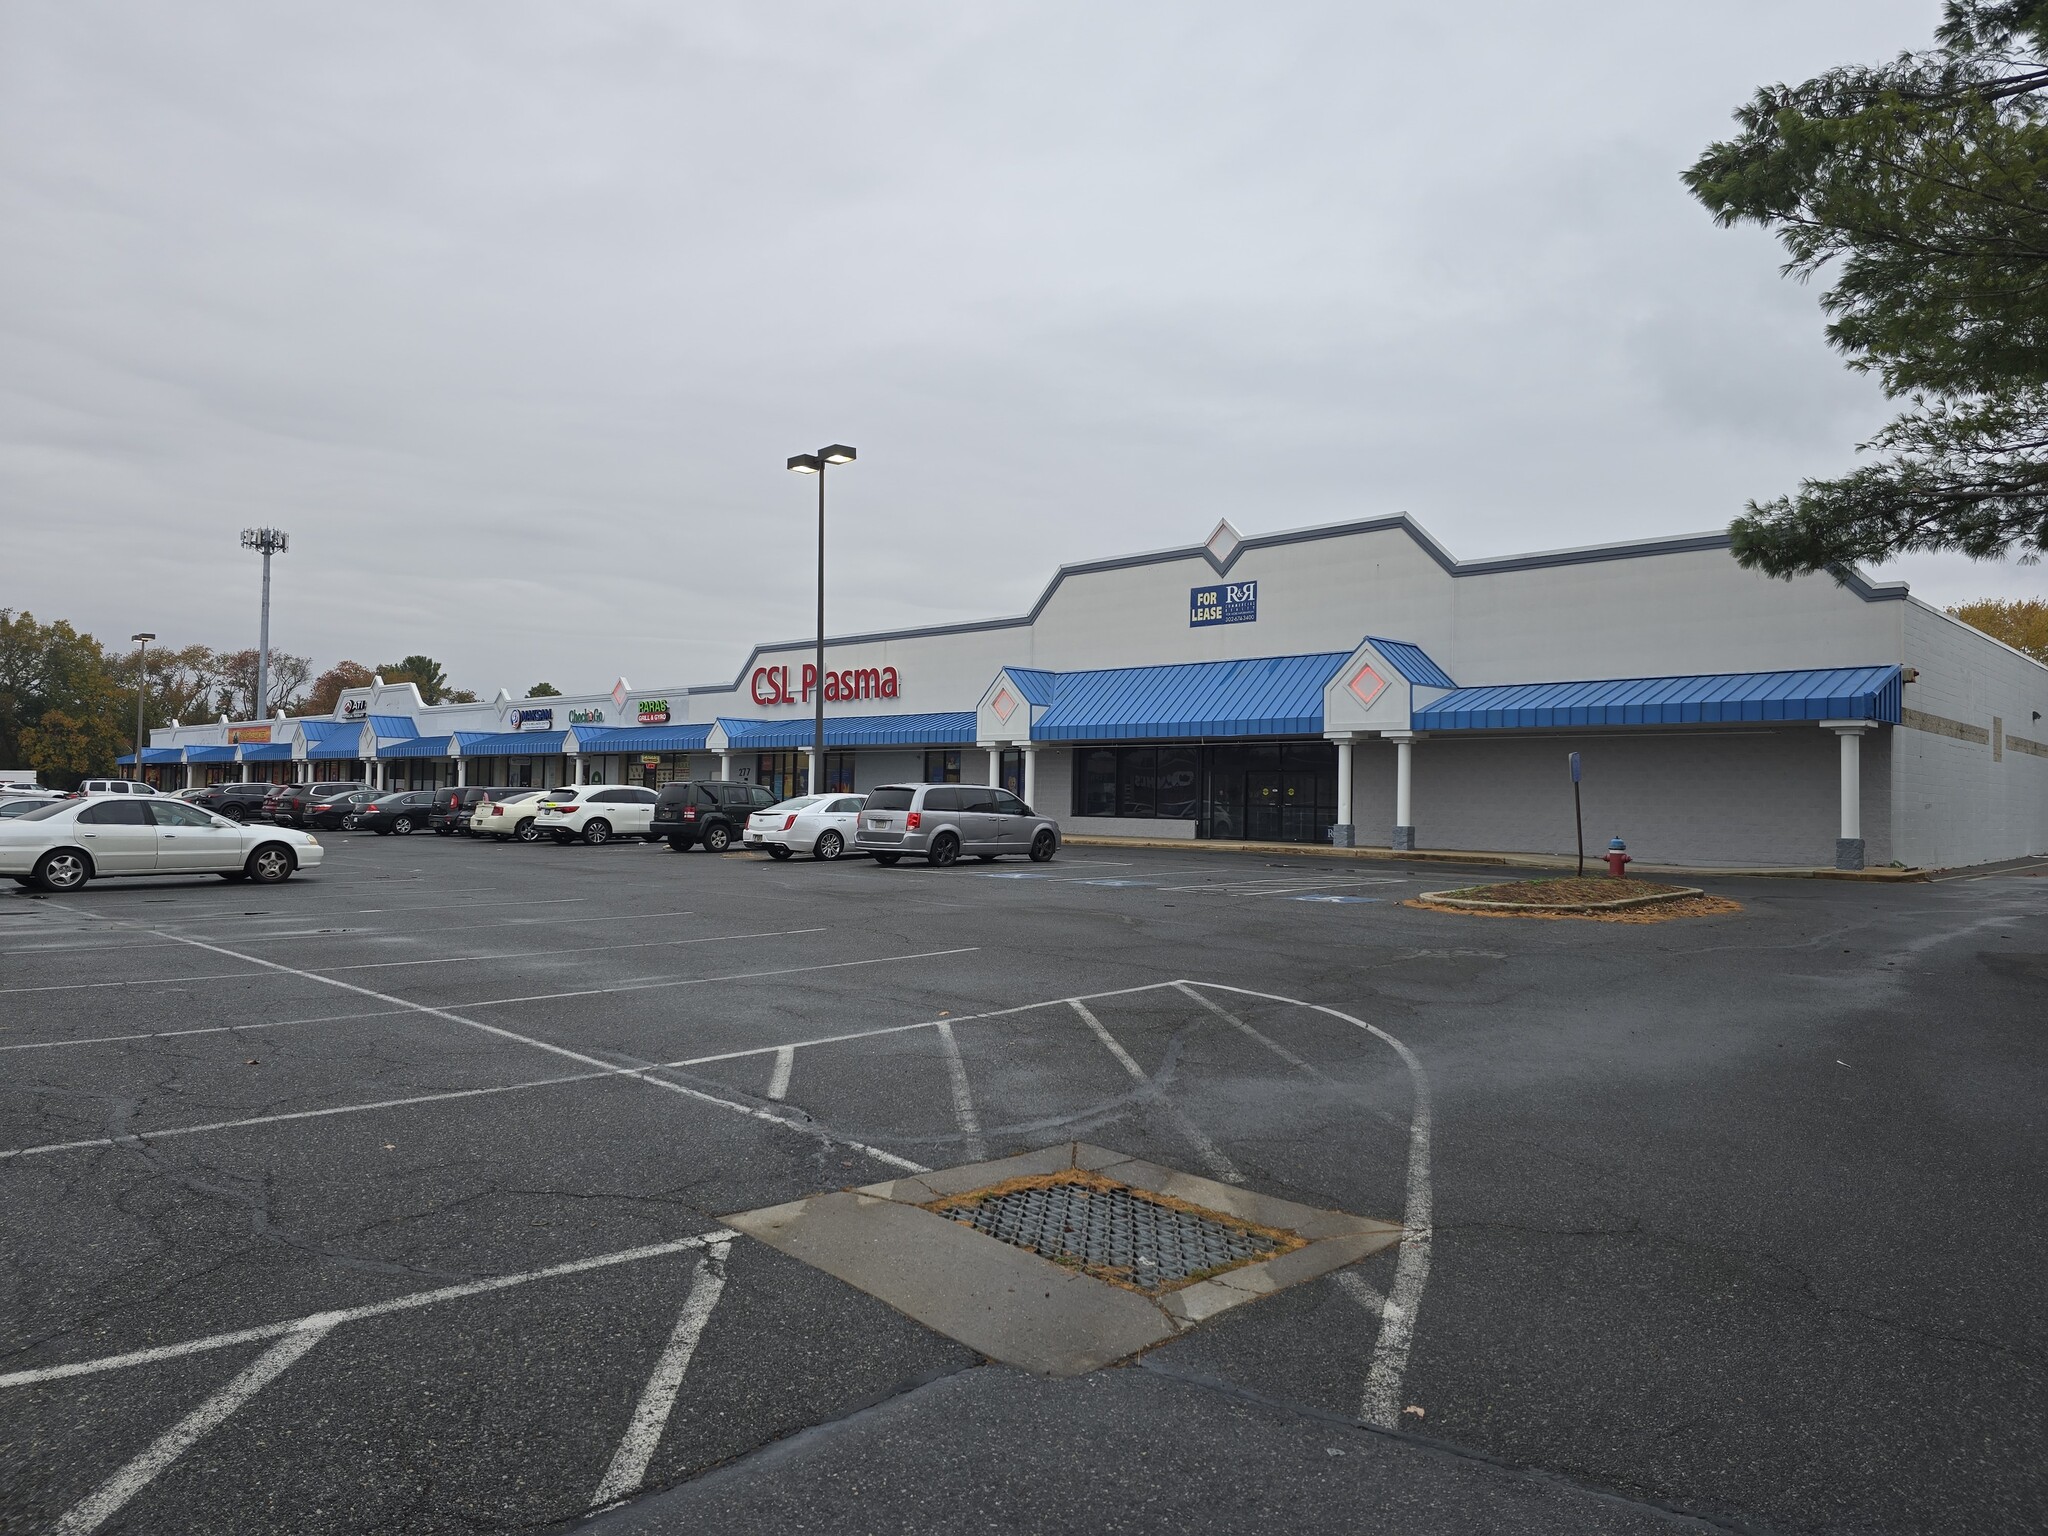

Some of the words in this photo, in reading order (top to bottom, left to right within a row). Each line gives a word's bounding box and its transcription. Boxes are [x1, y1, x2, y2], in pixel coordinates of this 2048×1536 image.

[1197, 592, 1217, 606] FOR
[1192, 606, 1222, 621] LEASE
[751, 666, 794, 705] CSL
[802, 664, 897, 702] Pasma
[639, 700, 667, 713] PARAS
[569, 709, 587, 724] Check
[594, 708, 604, 722] Go
[738, 767, 751, 777] 277
